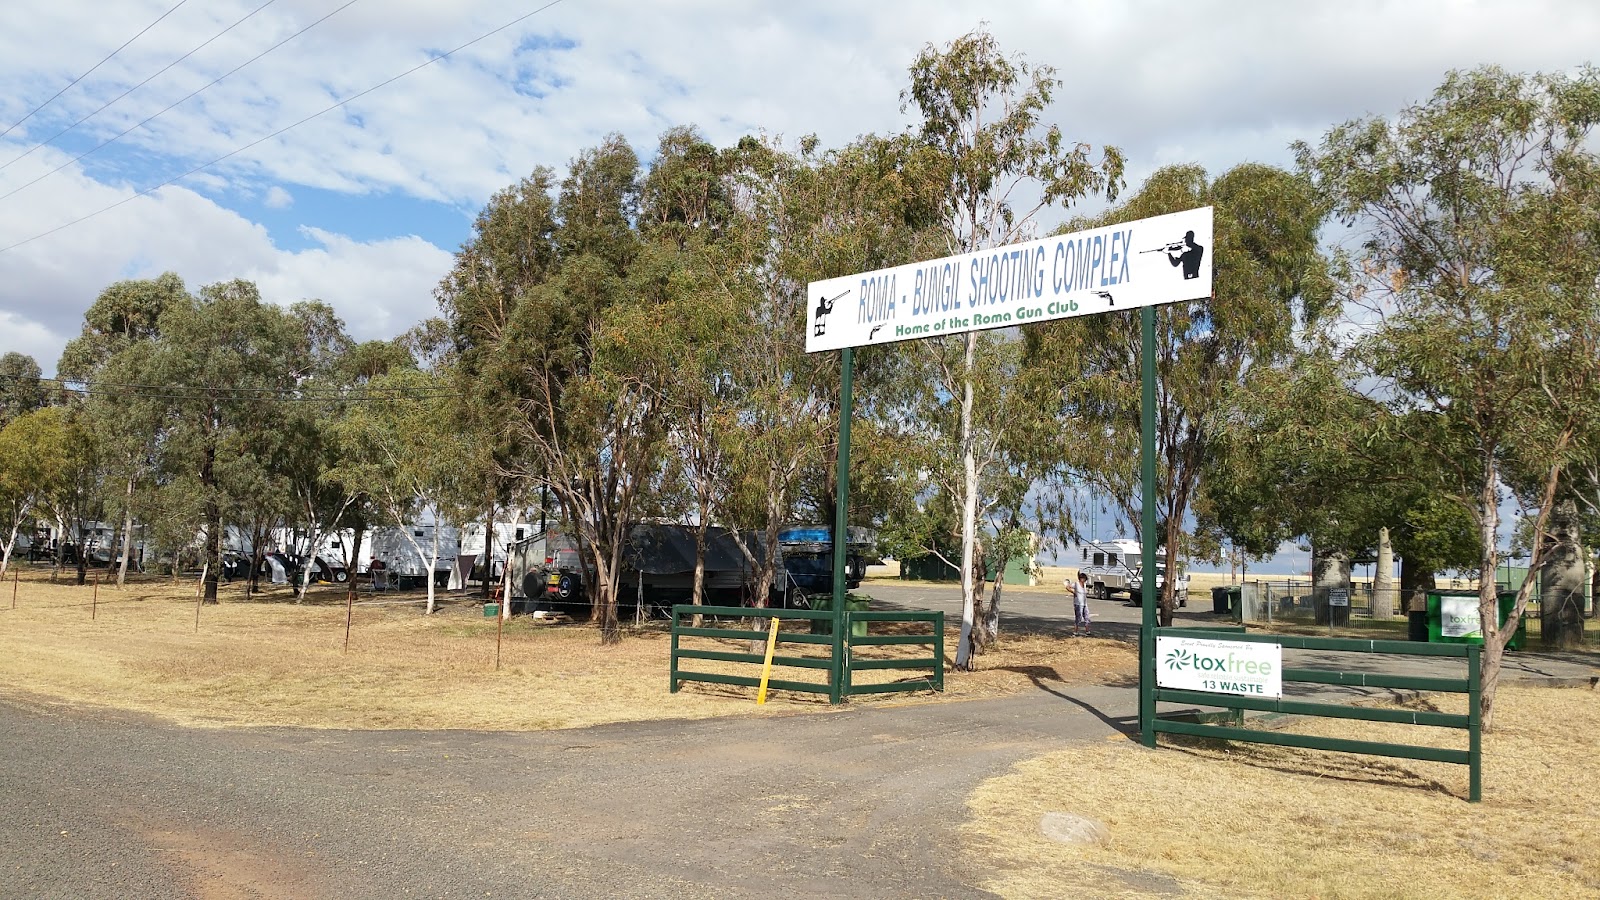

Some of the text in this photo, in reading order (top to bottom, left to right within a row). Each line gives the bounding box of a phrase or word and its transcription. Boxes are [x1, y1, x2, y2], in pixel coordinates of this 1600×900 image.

[858, 274, 896, 324] ROMA
[912, 262, 961, 316] BUNGIL
[968, 245, 1045, 308] SHOOTING
[1052, 229, 1133, 295] COMPLEX
[895, 299, 1079, 337] Home of the Roma Gun Club
[1450, 614, 1481, 624] toxfre
[1193, 652, 1271, 675] toxfree
[1202, 680, 1264, 694] 13 WASTE
